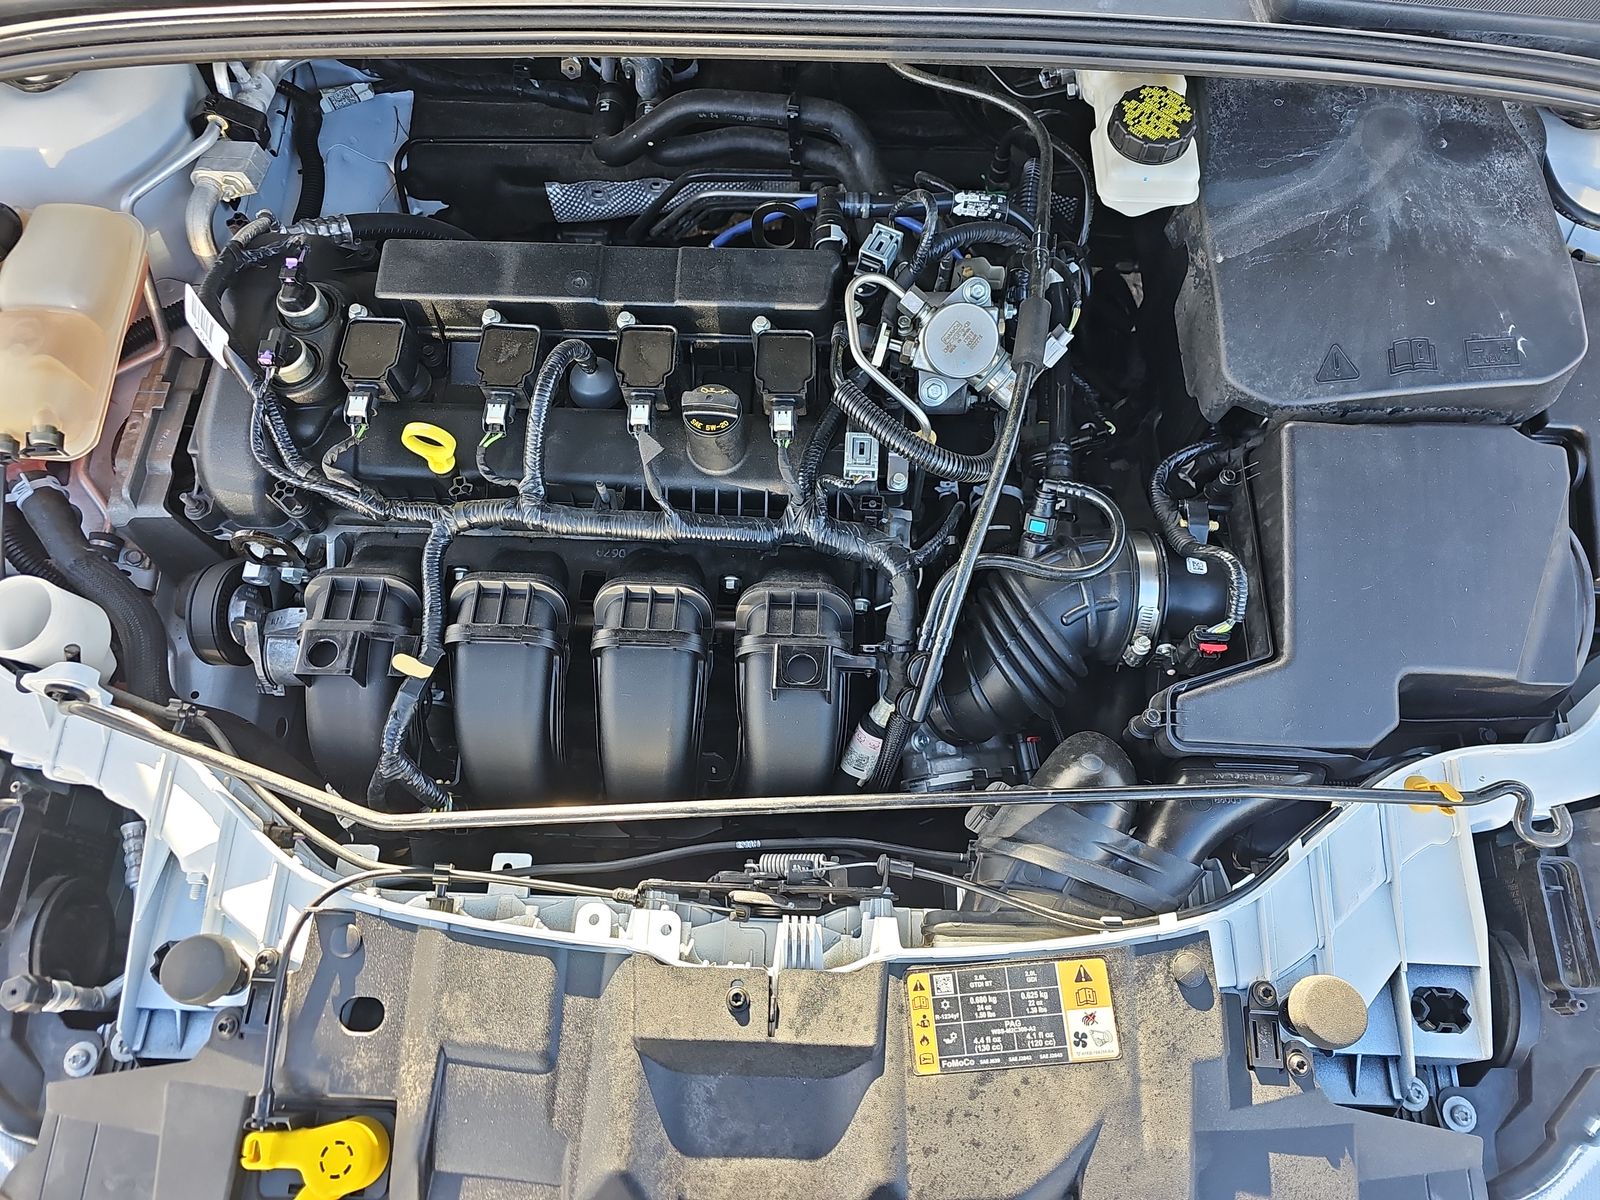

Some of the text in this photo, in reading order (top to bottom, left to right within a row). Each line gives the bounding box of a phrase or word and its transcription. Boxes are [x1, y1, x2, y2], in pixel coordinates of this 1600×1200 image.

[690, 418, 729, 431] SAE 5W-20
[988, 995, 997, 1004] kg
[1020, 991, 1048, 1000] 0.625 kg
[1004, 1020, 1022, 1028] PAG
[1026, 1032, 1036, 1040] 4.1
[992, 1043, 1004, 1052] cc)
[1028, 1038, 1056, 1049] (120 cc)
[942, 1058, 975, 1068] FoMoCo
